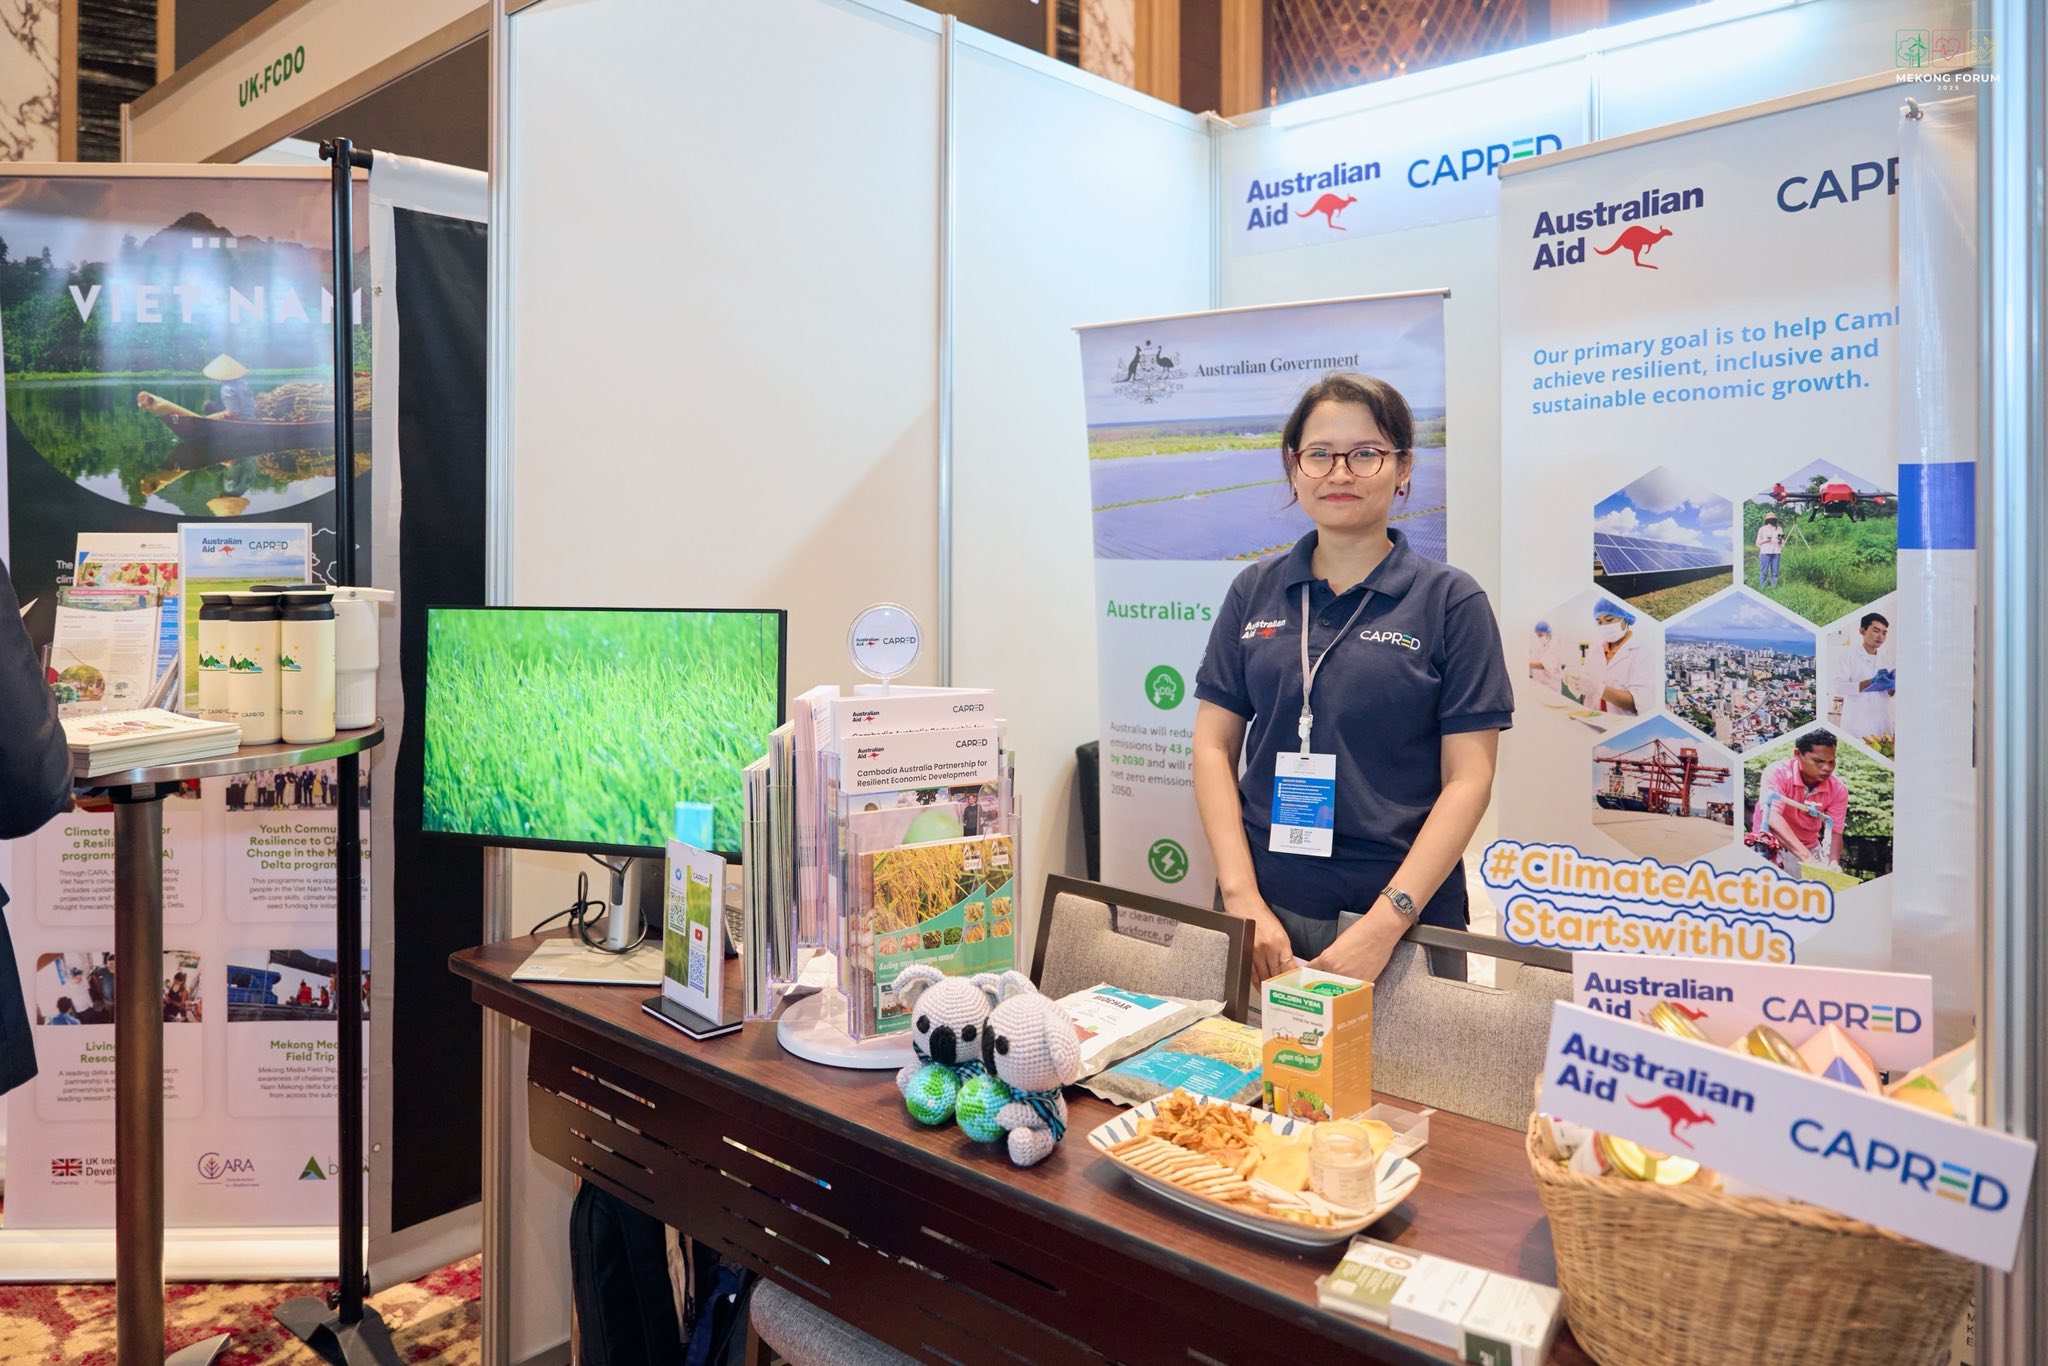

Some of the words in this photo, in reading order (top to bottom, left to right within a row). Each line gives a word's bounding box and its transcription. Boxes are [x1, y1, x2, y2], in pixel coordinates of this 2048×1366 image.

[238, 45, 305, 107] UK-FCDO
[1246, 161, 1381, 203] Australian
[1246, 203, 1288, 231] Aid
[1533, 187, 1704, 239] Australian
[1533, 237, 1586, 271] Aid
[69, 285, 193, 323] VIET
[1533, 348, 1568, 366] Our
[1574, 337, 1655, 364] primary
[1661, 329, 1708, 355] goal
[1715, 326, 1735, 346] is
[1742, 325, 1766, 343] to
[1773, 318, 1827, 345] help
[1195, 359, 1266, 378] Australian
[1270, 352, 1359, 373] Government
[1533, 371, 1606, 391] achieve
[1612, 357, 1708, 385] resilient,
[1715, 346, 1823, 373] inclusive
[1830, 337, 1880, 360] and
[1533, 389, 1647, 415] sustainable
[1652, 380, 1766, 404] economic
[1773, 370, 1870, 401] growth.
[202, 537, 242, 545] Australian
[249, 541, 288, 550] CAPRED
[56, 560, 73, 569] The
[56, 574, 74, 583] clim
[1107, 600, 1212, 621] Australia's
[1245, 619, 1286, 630] Australian
[882, 637, 916, 645] CAPRED
[1360, 630, 1421, 650] CAPRED
[953, 704, 984, 713] CAPRED
[1110, 722, 1147, 735] Australia
[1150, 727, 1167, 737] will
[1169, 729, 1193, 738] redu
[955, 739, 988, 748] CAPRED
[1110, 739, 1153, 751] emissions
[1156, 743, 1167, 754] by
[1170, 745, 1182, 754] 43
[857, 767, 898, 777] Cambodia
[899, 763, 933, 773] Australia
[934, 760, 976, 772] Partnership
[1110, 754, 1120, 764] by
[1122, 756, 1144, 767] 2030
[1147, 759, 1165, 769] and
[1168, 761, 1186, 771] will
[857, 777, 890, 787] Resilient
[891, 774, 927, 783] Economic
[928, 770, 978, 782] Development
[1110, 769, 1123, 779] net
[1125, 773, 1145, 783] zero
[1111, 784, 1134, 797] 2050.
[64, 827, 110, 836] Climate
[260, 825, 292, 833] Youth
[294, 824, 337, 833] Commu
[83, 839, 114, 848] Resili
[250, 836, 307, 845] Resilience
[310, 836, 321, 845] to
[247, 848, 291, 859] Change
[294, 848, 304, 857] in
[306, 847, 325, 857] the
[261, 861, 291, 869] Delta
[1488, 847, 1828, 914] #ClimateAction
[1129, 911, 1154, 923] clean
[1120, 925, 1162, 939] orkforce,
[1511, 903, 1789, 964] StartswithUs
[1272, 991, 1302, 1004] GOLDEN
[1303, 998, 1321, 1009] YEM
[1584, 971, 1734, 1003] Australian
[1762, 997, 1922, 1034] CAPRED
[1587, 998, 1631, 1020] Aid
[86, 1042, 114, 1051] Livin
[271, 1040, 313, 1051] Mekong
[80, 1054, 115, 1063] Resea
[286, 1052, 312, 1061] Field
[314, 1052, 334, 1062] Trip
[1561, 1033, 1755, 1112] Australian
[1556, 1065, 1617, 1102] Aid
[1789, 1118, 2010, 1212] CAPRED
[86, 1167, 116, 1176] Devel
[198, 1152, 254, 1179] CARA
